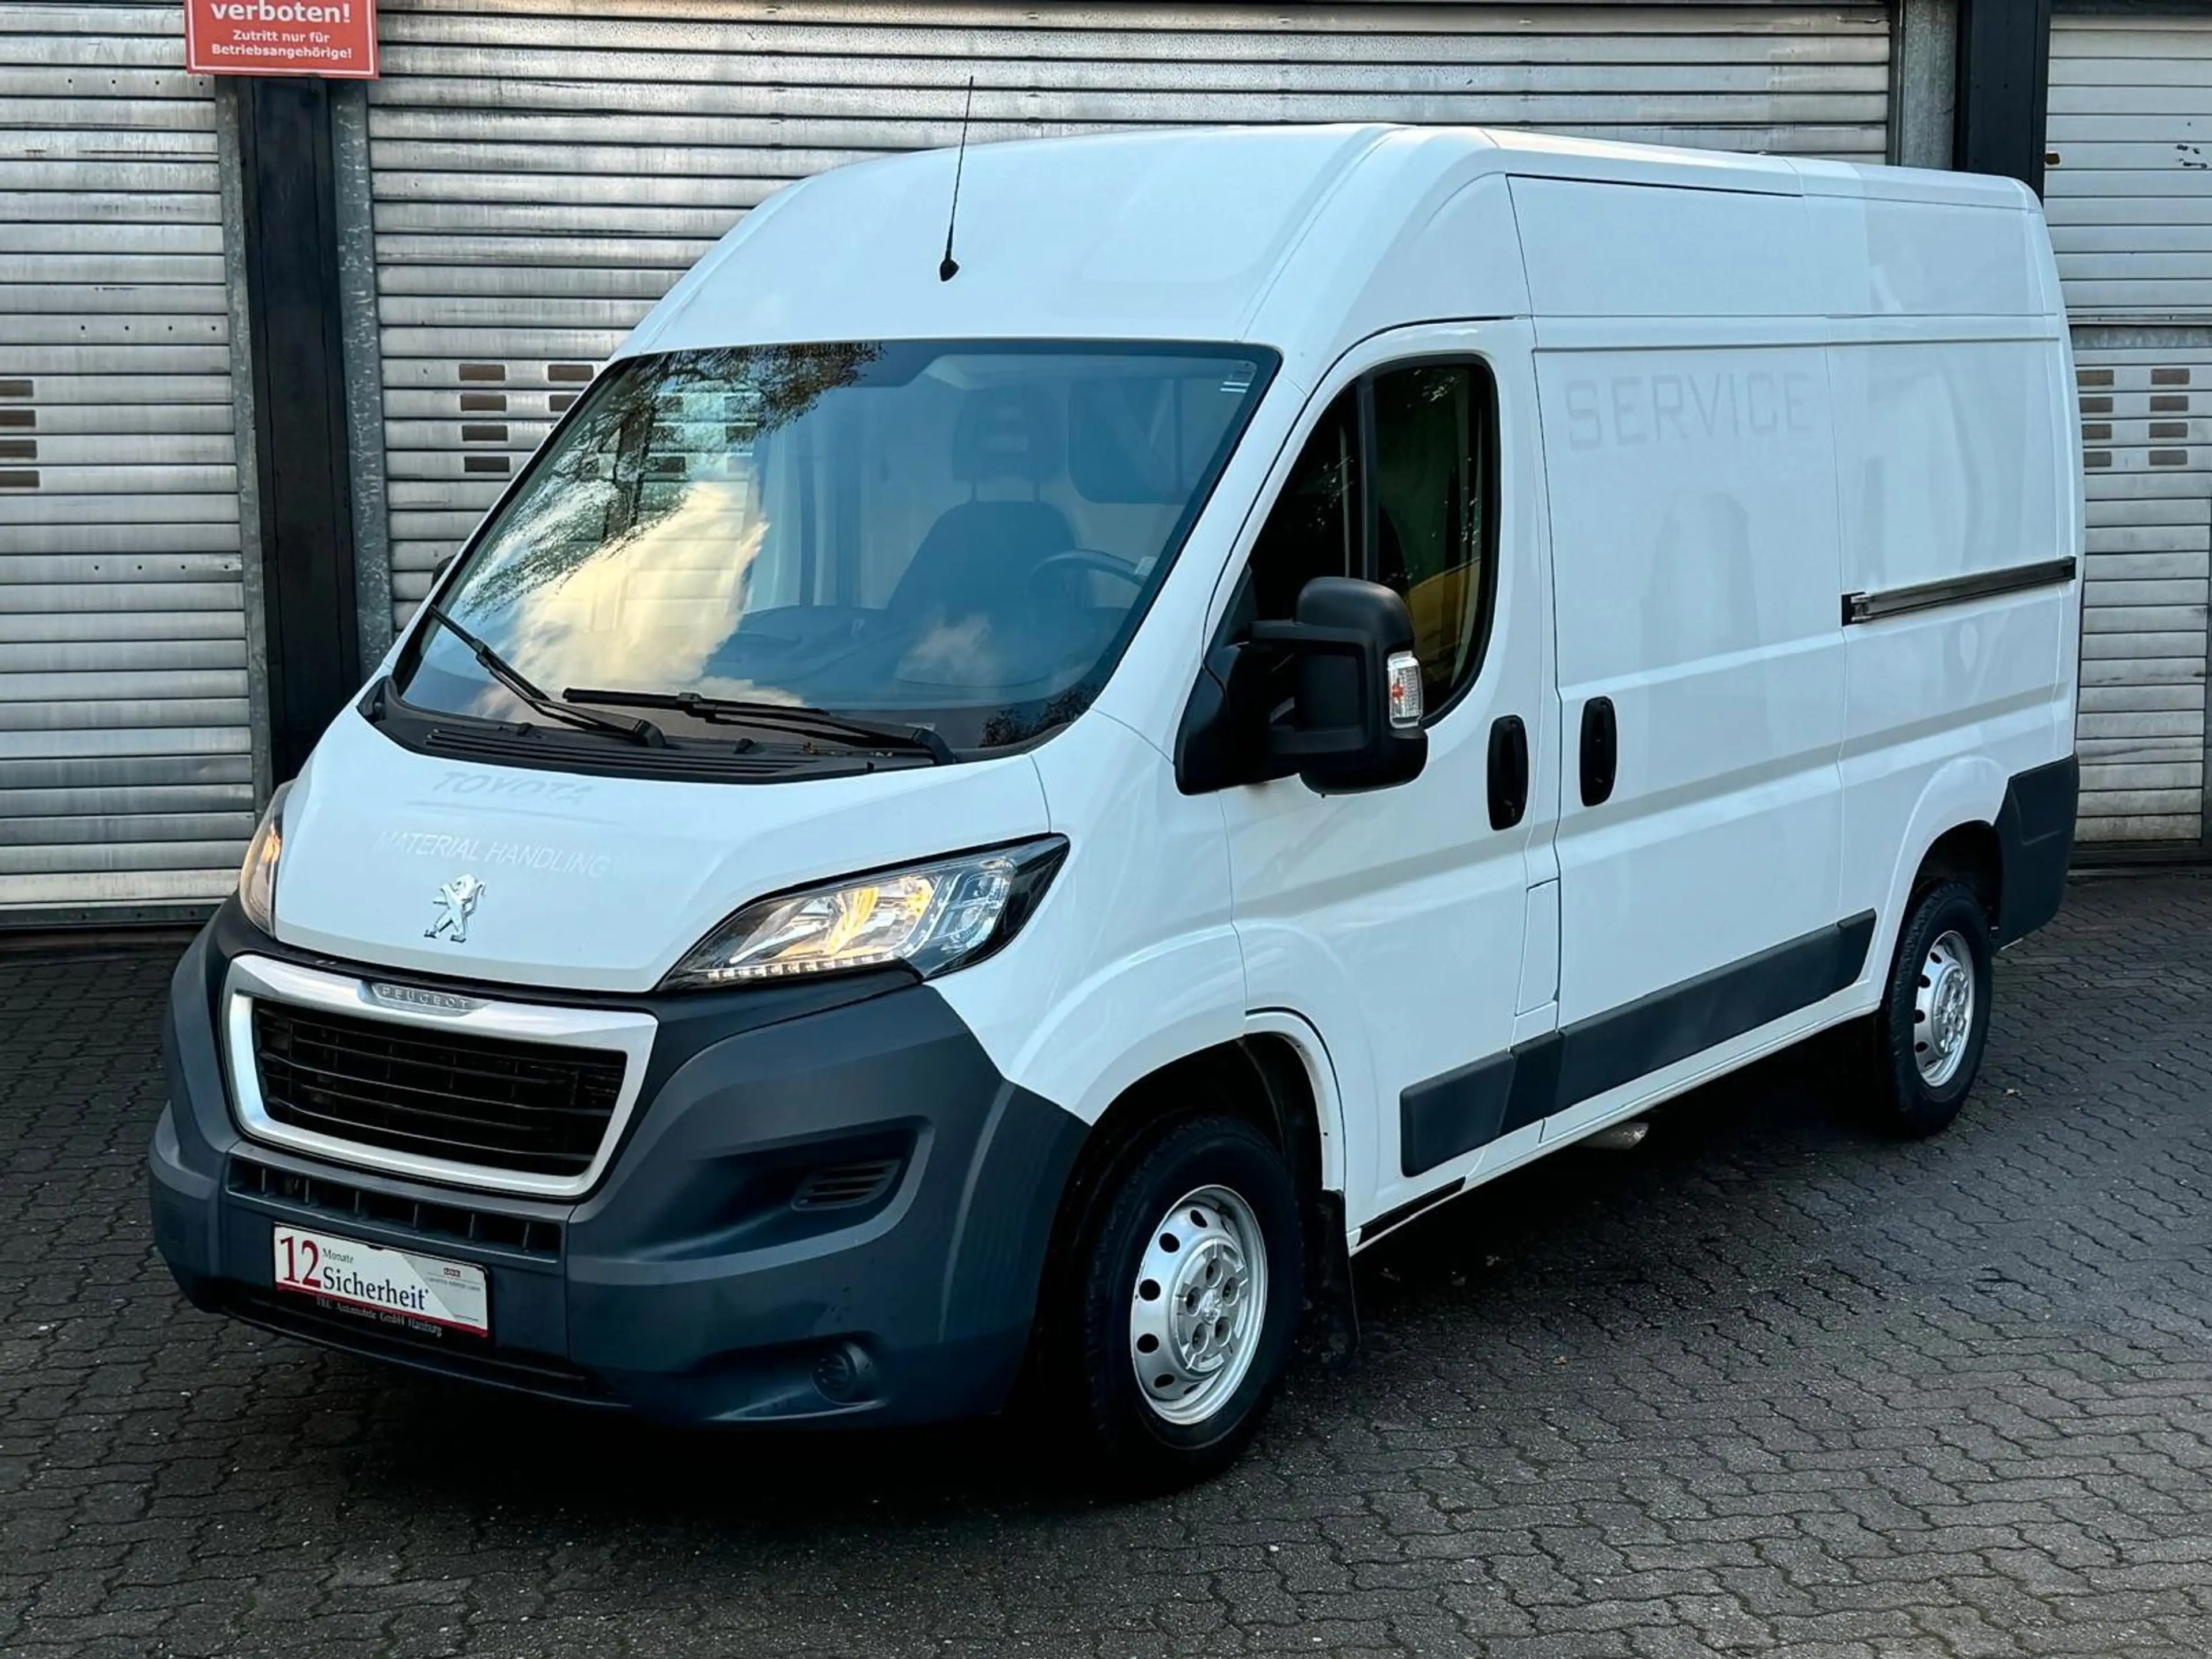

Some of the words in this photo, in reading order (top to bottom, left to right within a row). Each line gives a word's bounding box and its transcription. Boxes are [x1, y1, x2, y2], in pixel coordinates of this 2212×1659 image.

[211, 0, 351, 23] verboten!
[233, 29, 279, 41] Zutritt
[282, 33, 306, 42] nur
[309, 32, 331, 43] für
[211, 44, 353, 60] Betriebsangehörige!
[1565, 372, 1813, 450] SERVICE
[432, 771, 593, 805] TOYOTA
[372, 831, 479, 862] MATERIAL
[484, 840, 611, 877] HANDLING
[382, 986, 469, 1009] PEUGEOT
[280, 1236, 321, 1289] 12
[323, 1247, 354, 1264] Monate
